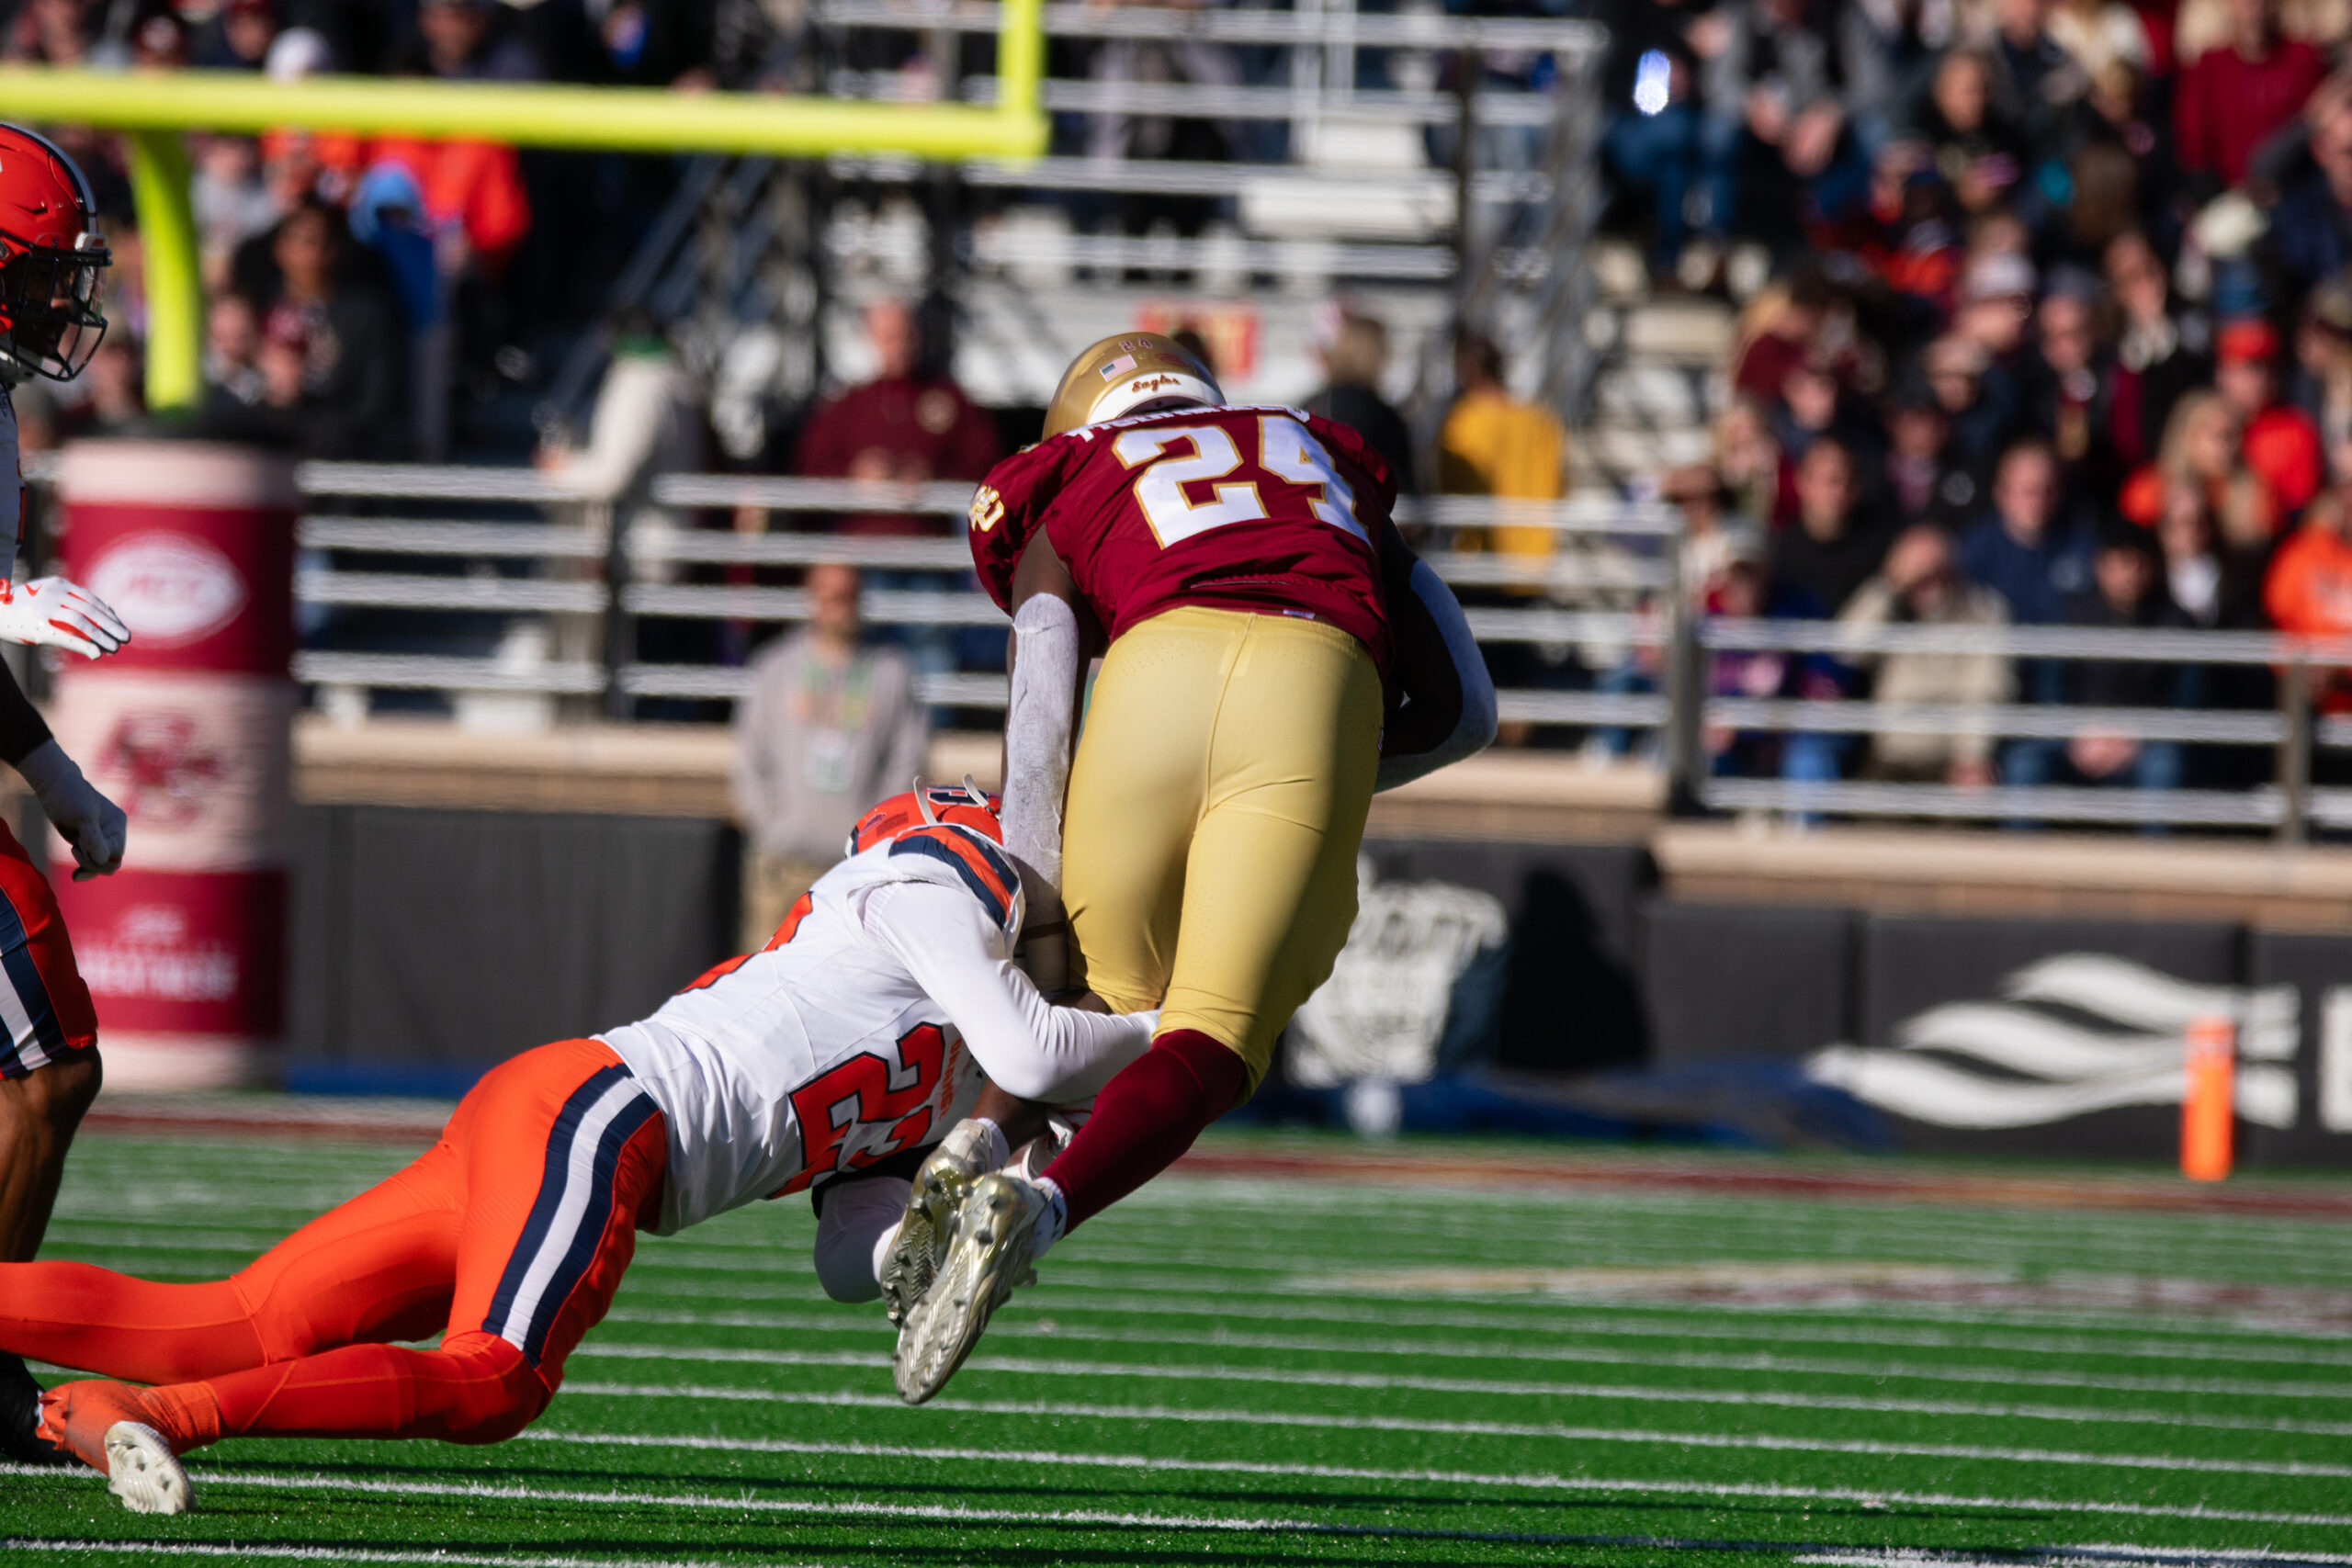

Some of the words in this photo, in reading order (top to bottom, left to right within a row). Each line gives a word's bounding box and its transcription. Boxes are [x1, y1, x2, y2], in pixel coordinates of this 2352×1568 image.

[1118, 337, 1153, 353] 24
[1131, 374, 1182, 392] Eagles
[1111, 414, 1374, 550] 24
